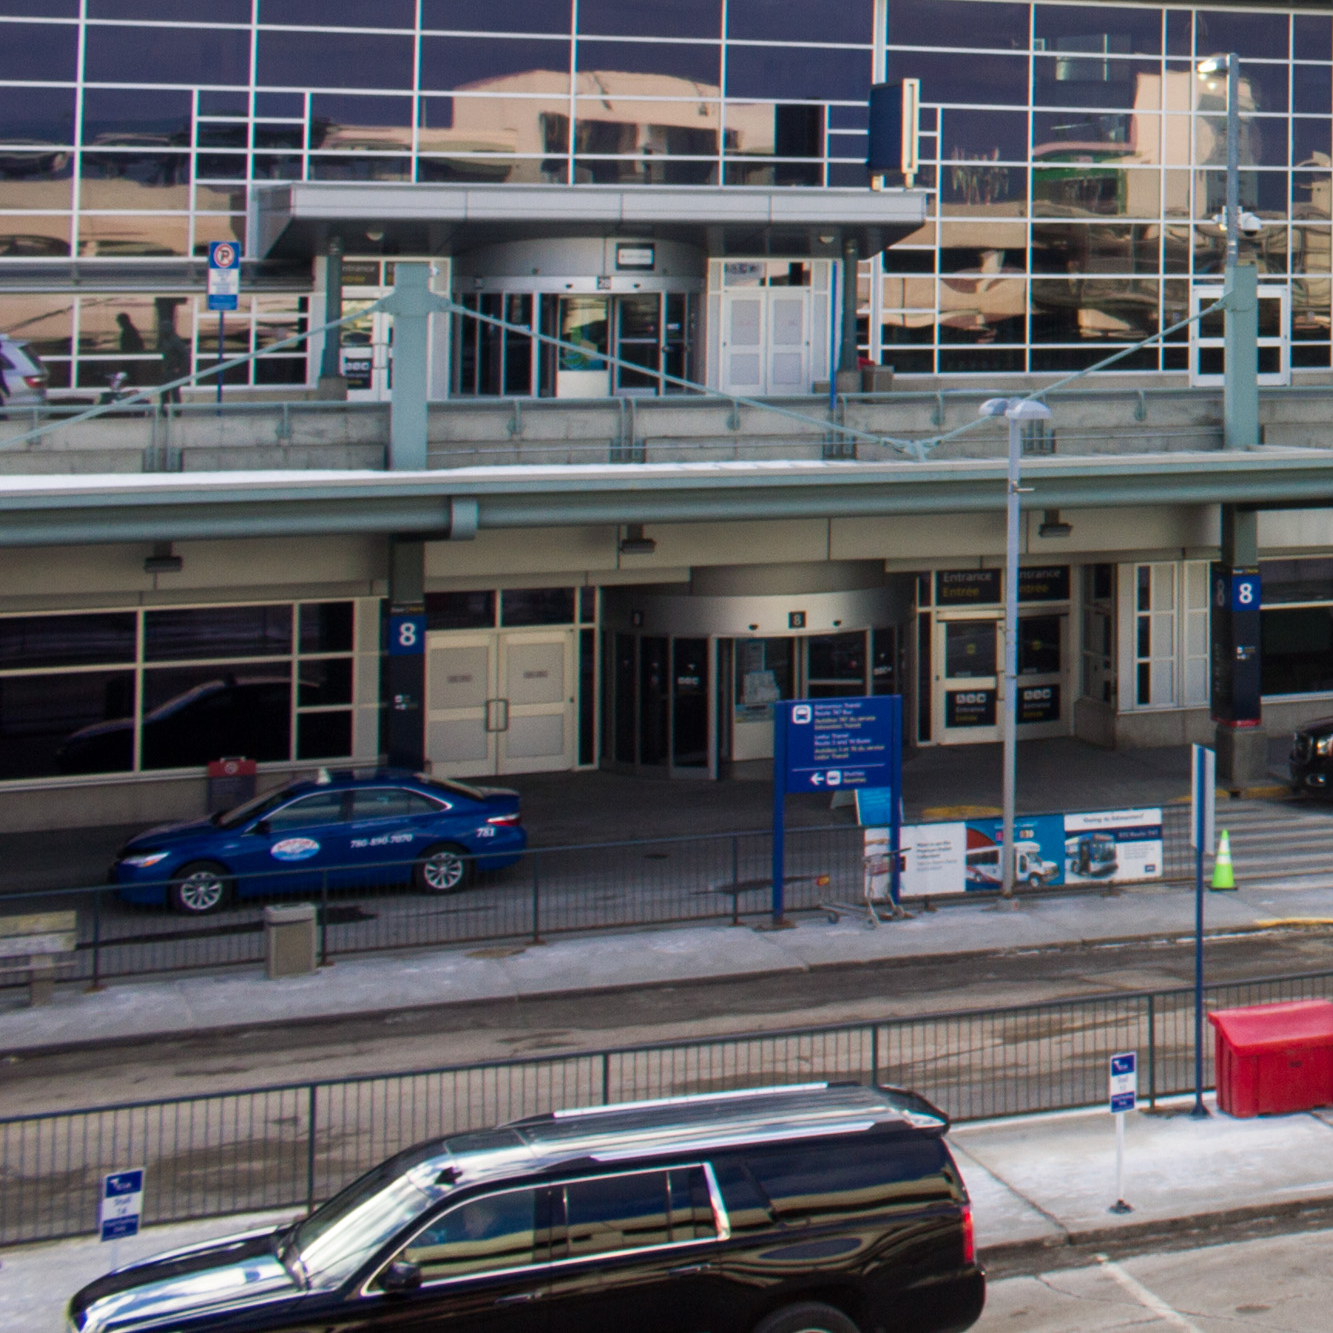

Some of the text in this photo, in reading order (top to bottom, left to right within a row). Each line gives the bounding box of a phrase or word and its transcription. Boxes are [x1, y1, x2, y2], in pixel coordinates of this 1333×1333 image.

[943, 571, 992, 583] Entrance
[1019, 568, 1061, 580] ntrance
[1019, 584, 1049, 594] ntrée
[1239, 583, 1253, 604] 8
[399, 622, 416, 646] 8
[476, 826, 496, 838] 781
[350, 833, 413, 849] 780-890-7070
